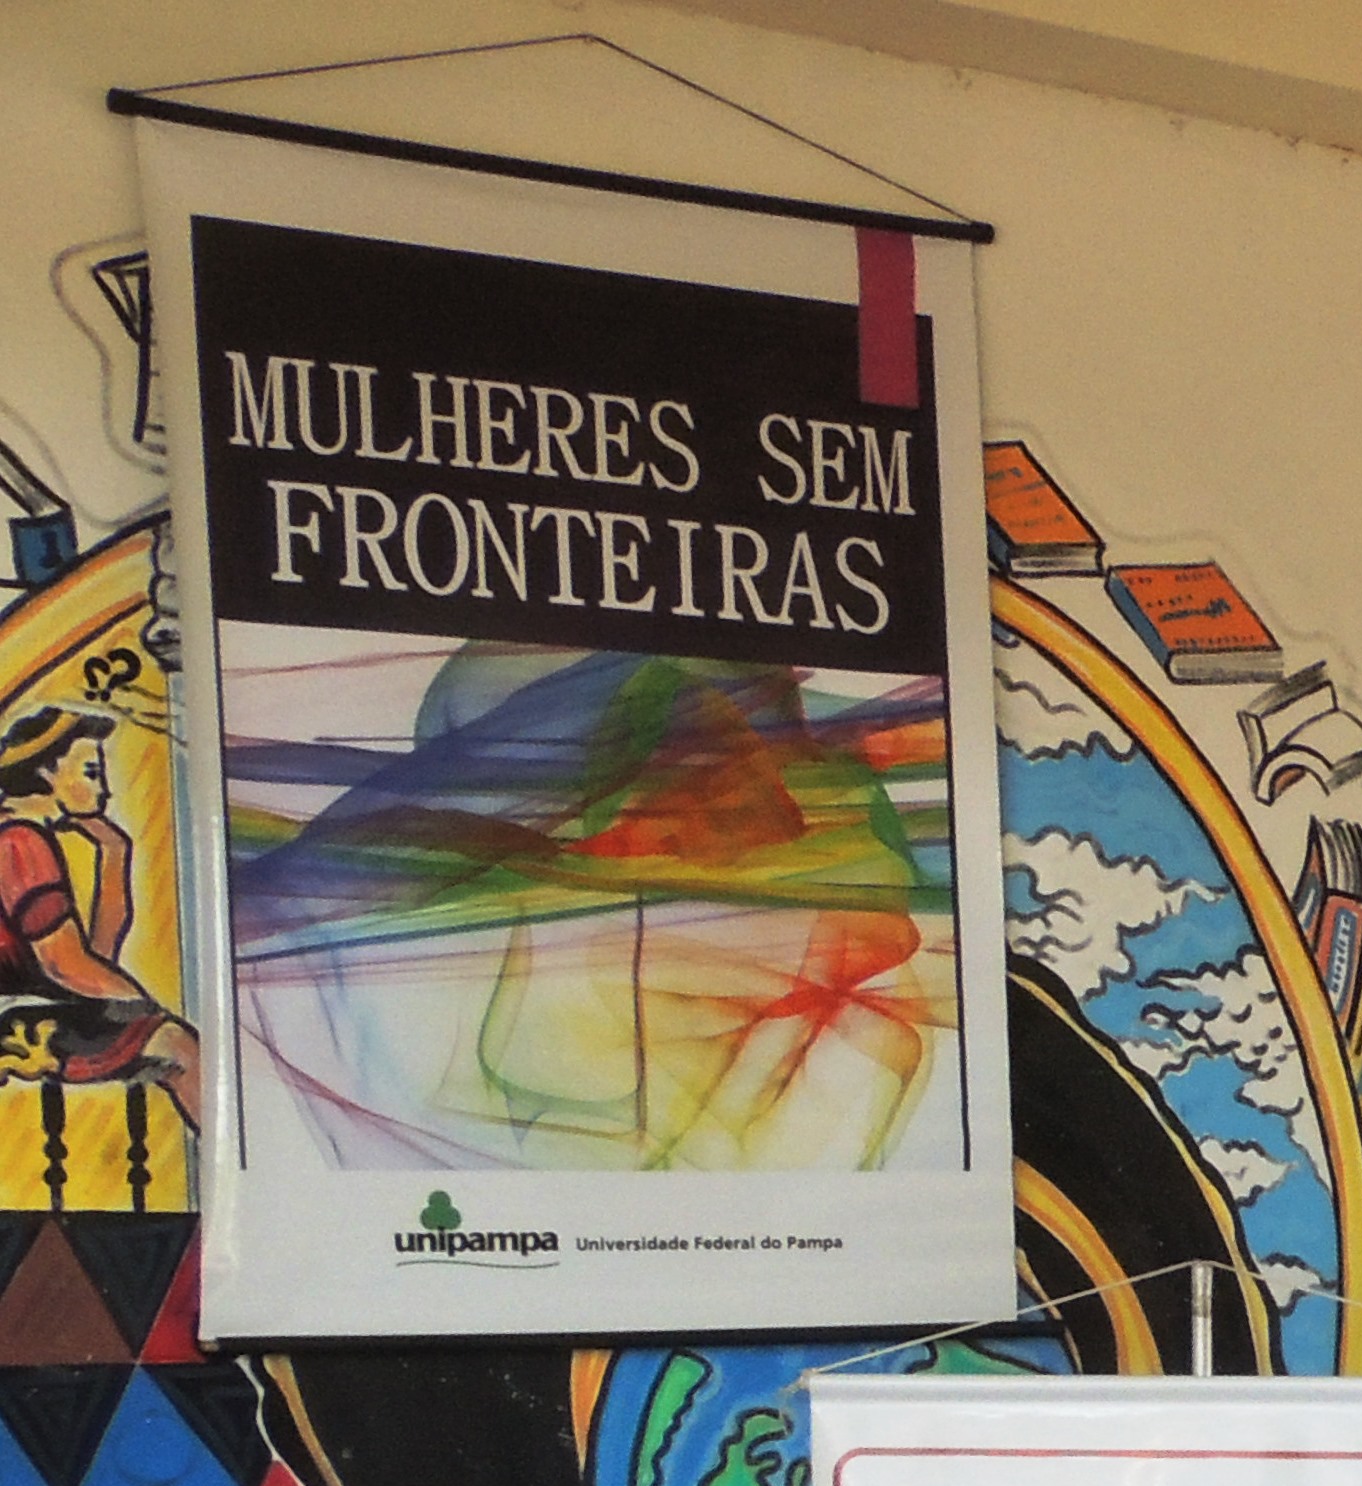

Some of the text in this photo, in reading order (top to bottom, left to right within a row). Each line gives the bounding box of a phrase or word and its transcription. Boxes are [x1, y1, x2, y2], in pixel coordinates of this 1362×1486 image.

[226, 350, 918, 517] MULHERES SEM
[268, 479, 890, 636] FRONTEIRAS
[394, 1226, 560, 1257] unipampa
[576, 1235, 843, 1253] Universidade Federal do Pampa
